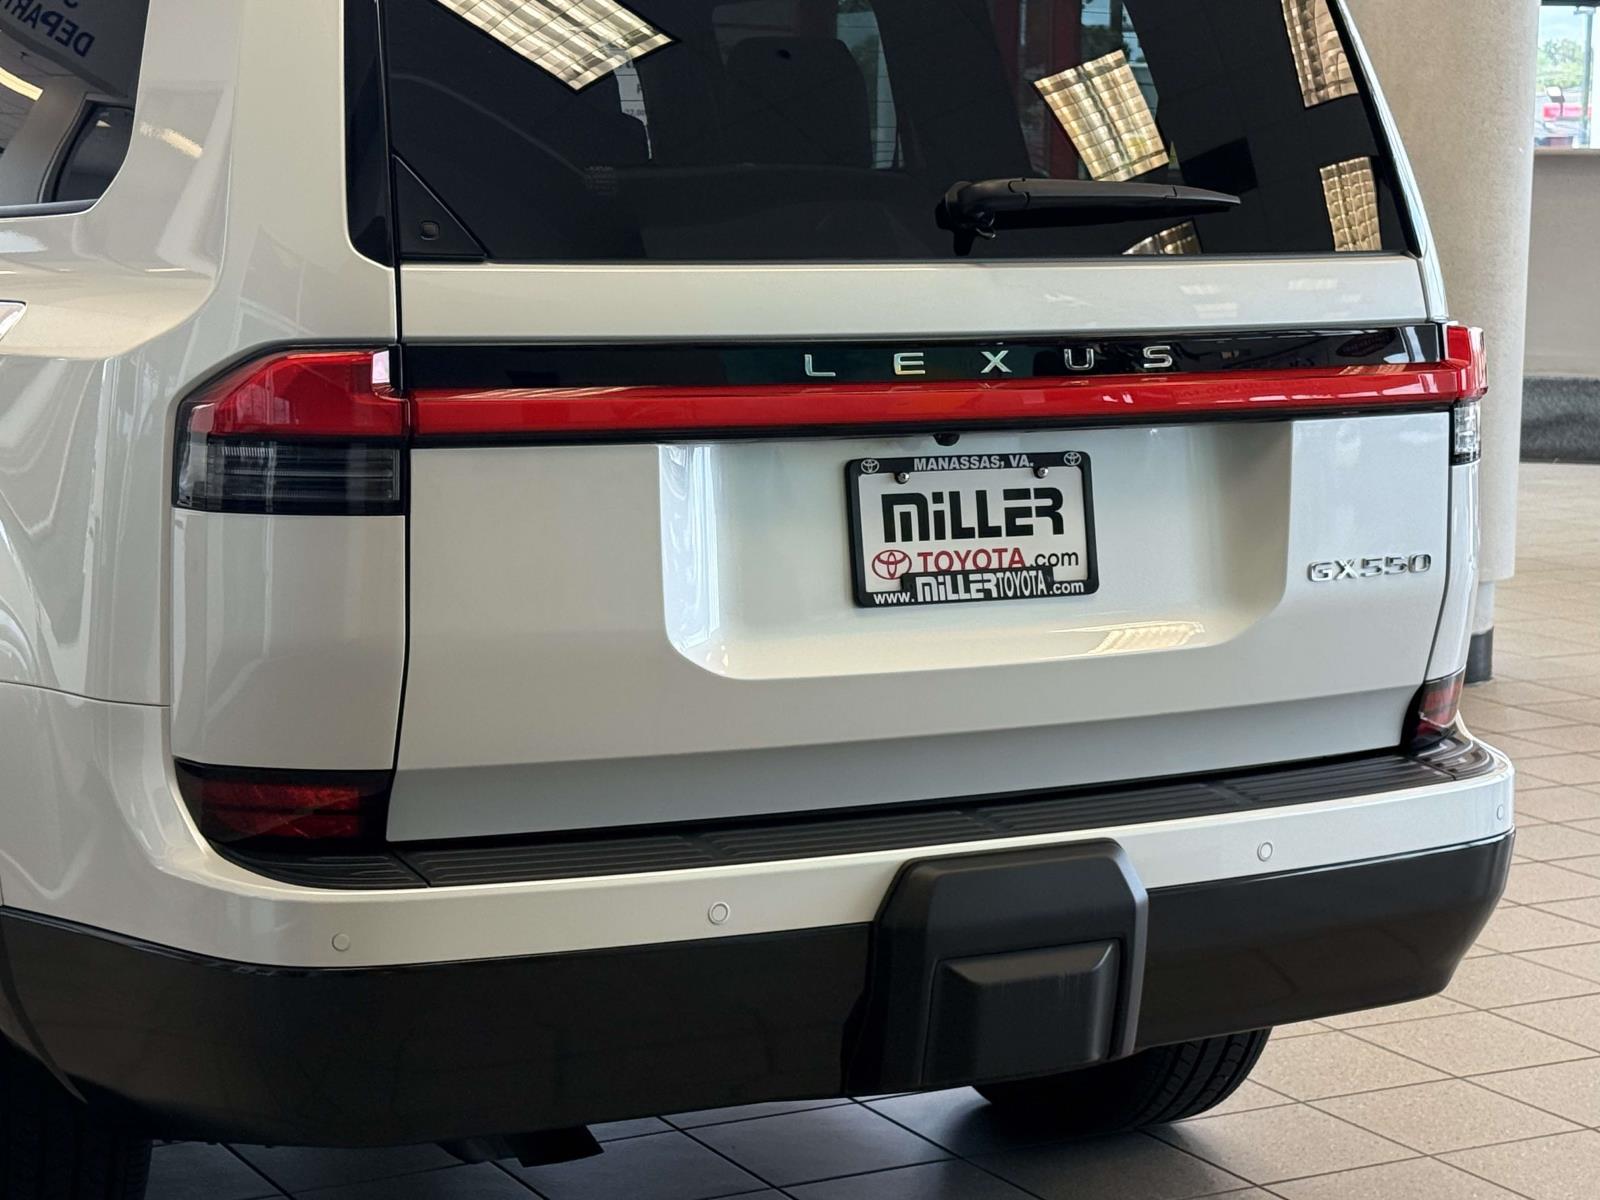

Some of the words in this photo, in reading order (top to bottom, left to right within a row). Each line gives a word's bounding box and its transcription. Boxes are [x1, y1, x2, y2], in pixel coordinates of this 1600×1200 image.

[804, 345, 1172, 377] LEXUS
[913, 455, 1005, 471] MANASSAS,
[1009, 454, 1034, 468] VA.
[1307, 553, 1432, 582] GX550
